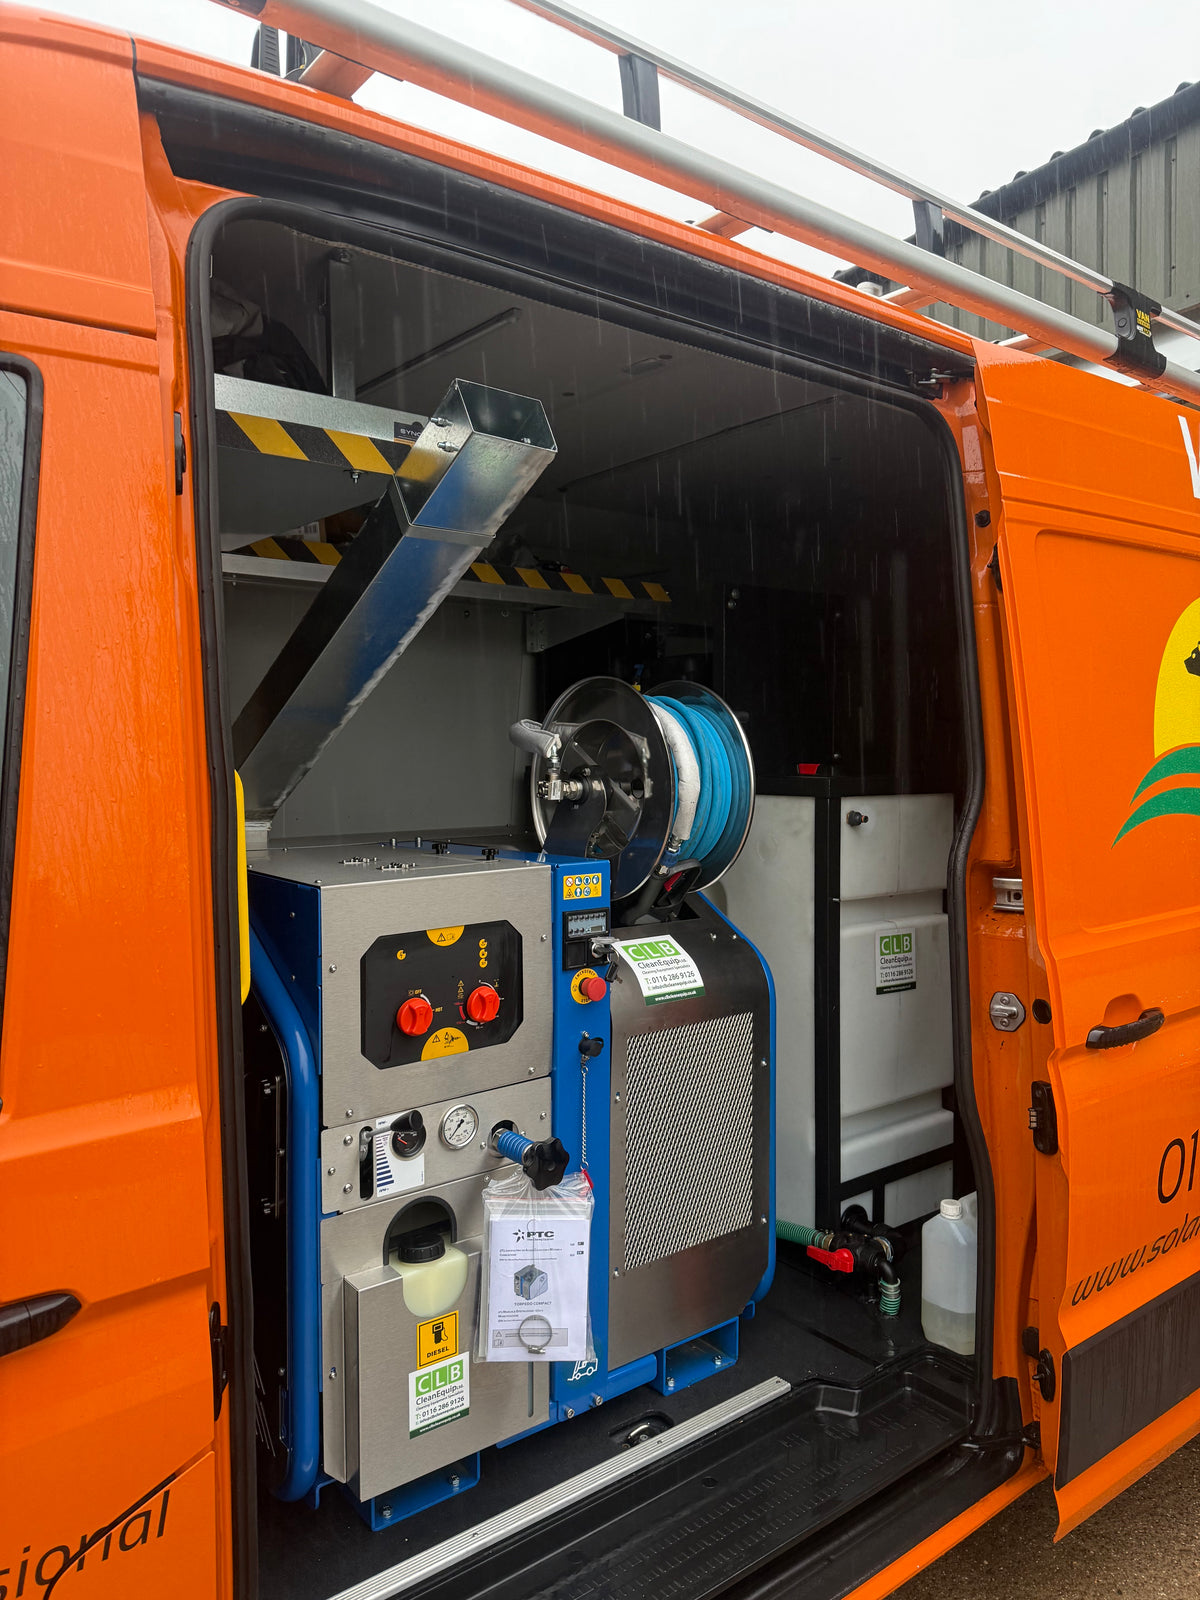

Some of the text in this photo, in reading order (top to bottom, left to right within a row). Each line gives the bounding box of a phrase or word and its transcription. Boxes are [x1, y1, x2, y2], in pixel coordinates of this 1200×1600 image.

[1136, 308, 1150, 323] VAN
[628, 942, 675, 959] CLB
[881, 936, 910, 954] CLB
[575, 969, 596, 979] EMERGENCY
[652, 974, 667, 984] 0116
[667, 972, 680, 981] 286
[680, 970, 695, 979] 9126
[526, 1230, 555, 1238] PTC
[426, 1346, 450, 1358] DIESEL
[418, 1364, 461, 1393] CLB
[416, 1384, 457, 1405] CleanEquip
[422, 1407, 437, 1418] 0116
[438, 1402, 449, 1411] 286
[450, 1396, 465, 1407] 9126
